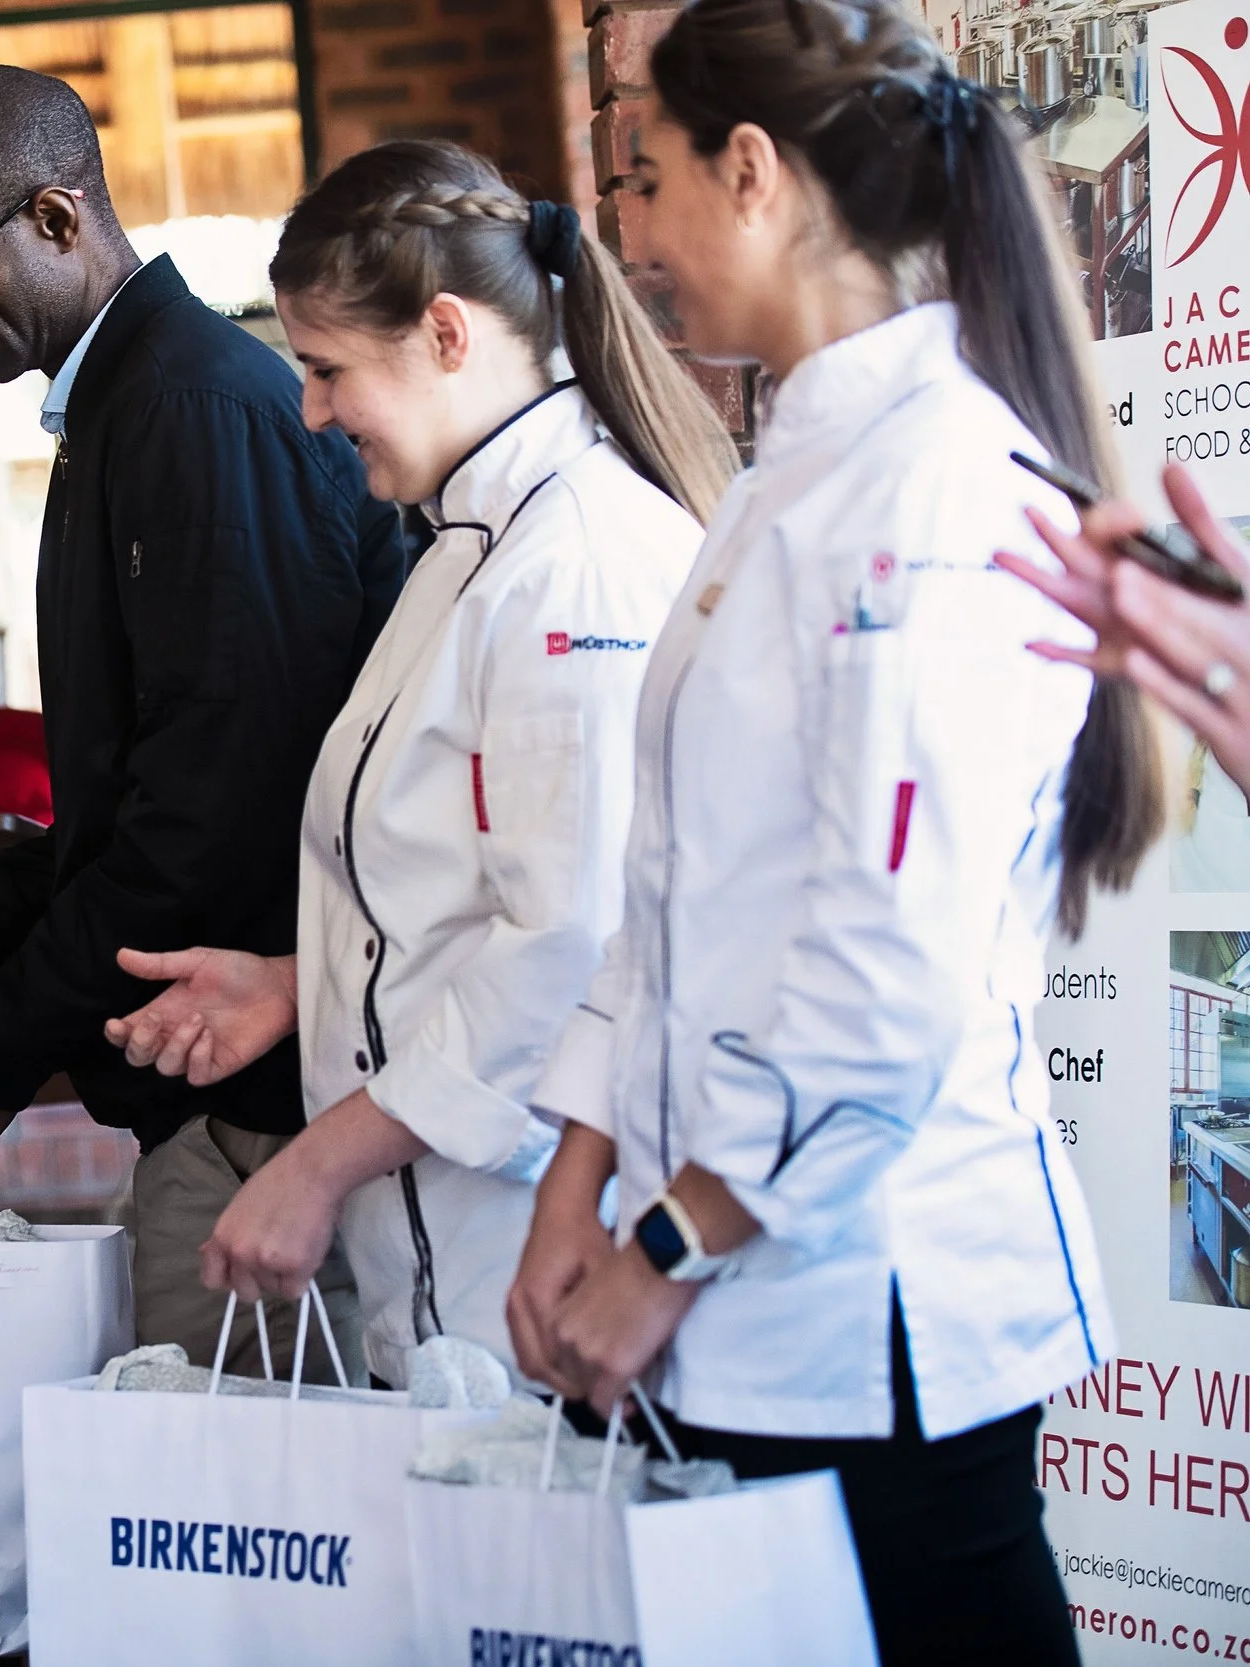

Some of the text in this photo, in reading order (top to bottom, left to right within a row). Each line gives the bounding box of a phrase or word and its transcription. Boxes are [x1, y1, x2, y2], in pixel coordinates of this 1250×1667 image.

[1166, 430, 1230, 464] FOOD
[1049, 1047, 1104, 1082] Chef
[1034, 1432, 1250, 1523] RTS HER
[111, 1516, 352, 1588] BIRKENSTOCK
